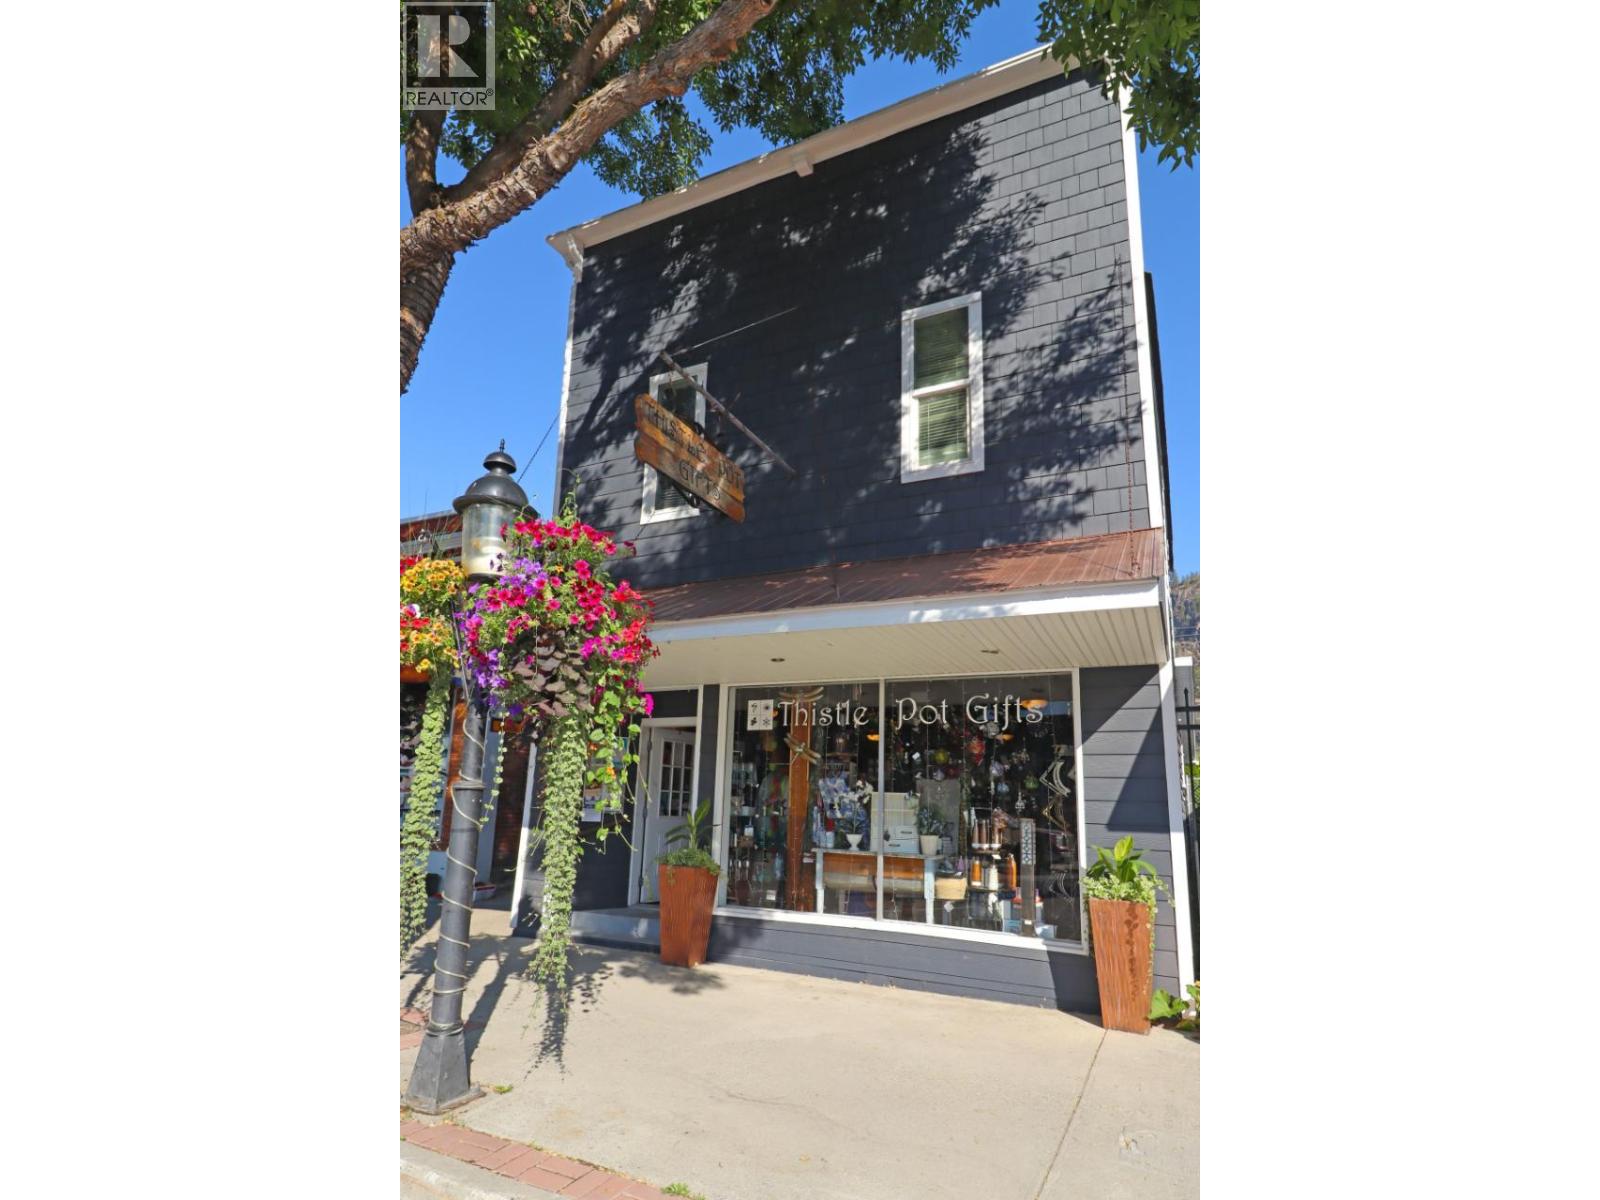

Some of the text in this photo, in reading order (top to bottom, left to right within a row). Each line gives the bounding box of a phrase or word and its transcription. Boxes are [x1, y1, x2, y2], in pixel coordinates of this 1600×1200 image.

[778, 693, 1043, 731] Thistle Pot Gifts
